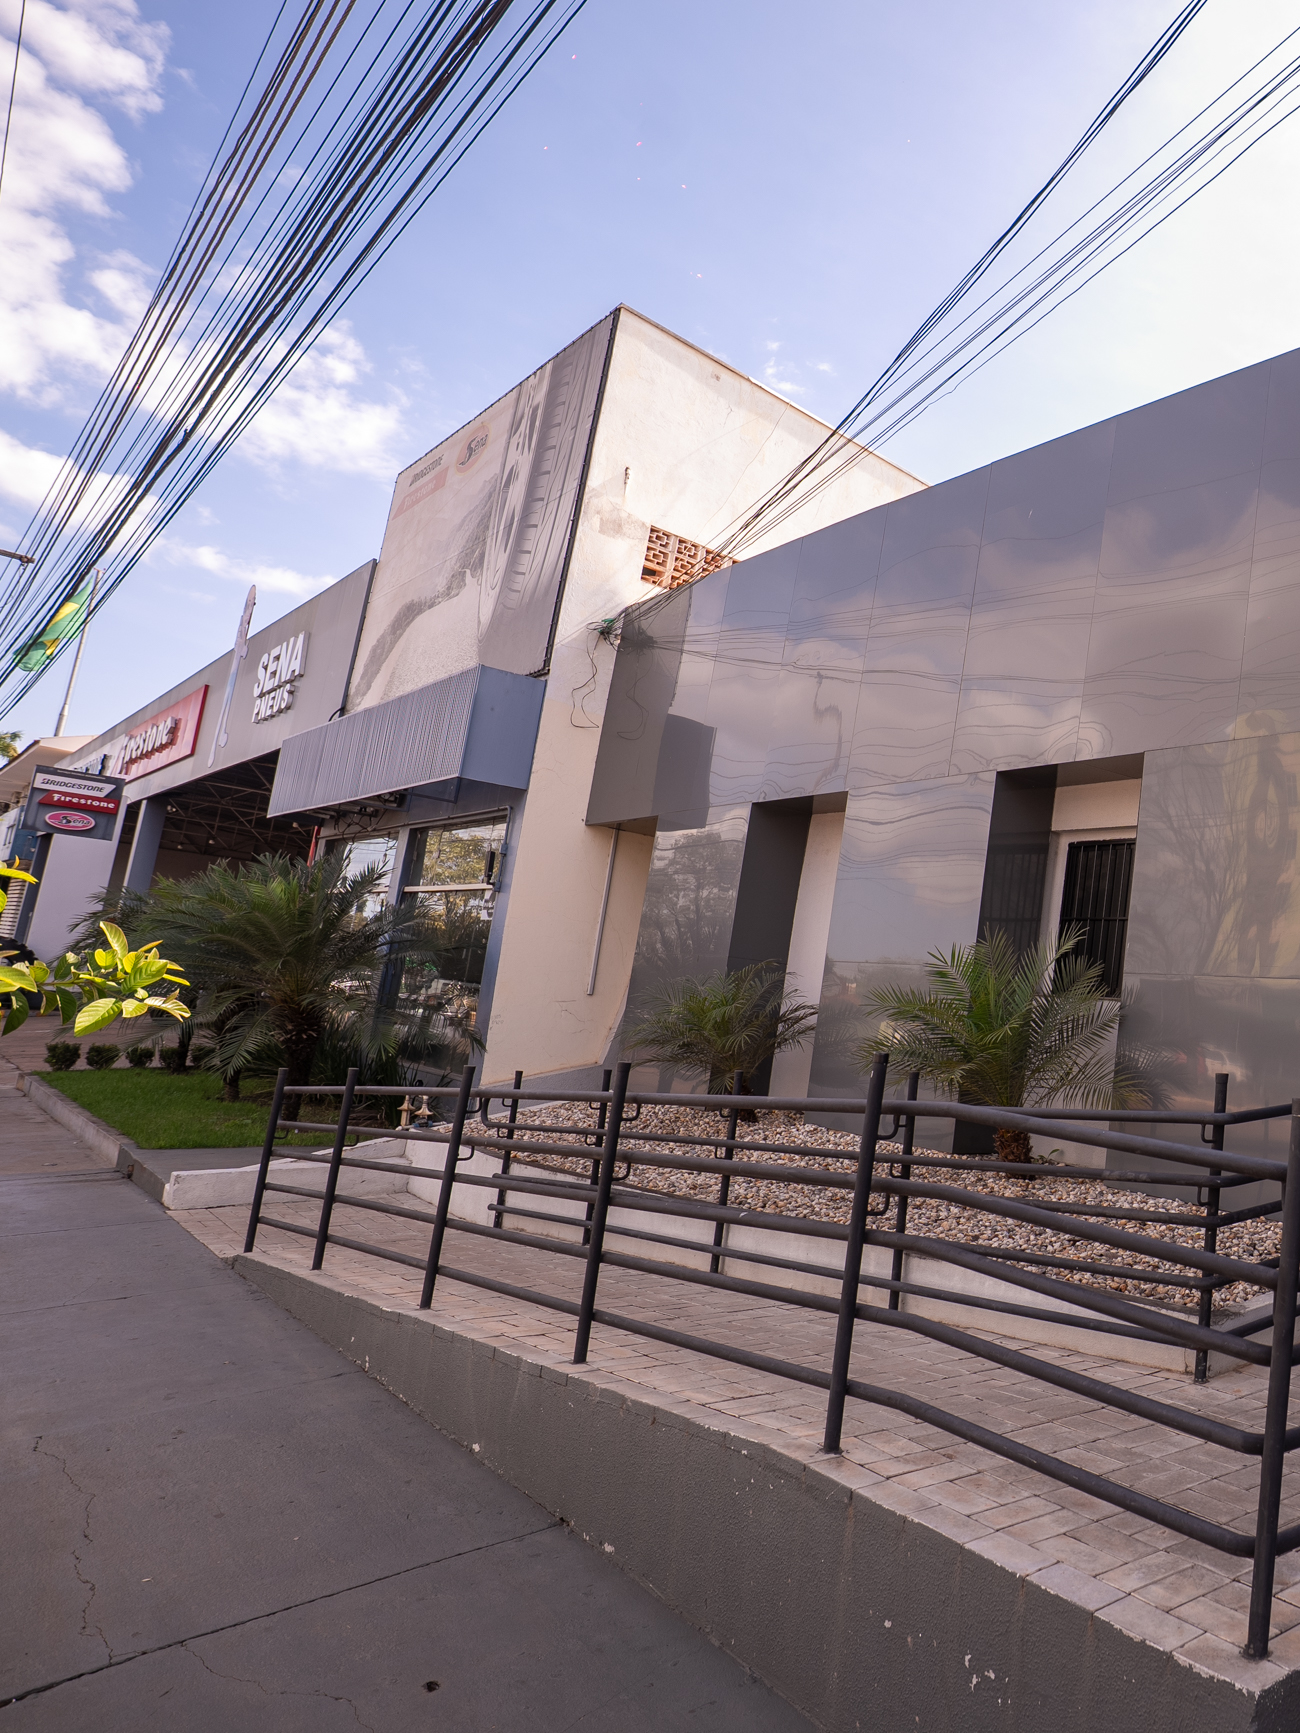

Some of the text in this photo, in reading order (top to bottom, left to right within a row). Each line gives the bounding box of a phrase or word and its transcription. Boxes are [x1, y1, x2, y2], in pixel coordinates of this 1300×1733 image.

[458, 433, 489, 466] Sena
[403, 479, 437, 509] Firestone
[253, 631, 306, 698] SENA
[252, 684, 294, 724] PNEUS
[40, 777, 107, 793] BRIDGESTONE
[52, 793, 116, 809] Firestone
[56, 814, 91, 826] Sena
